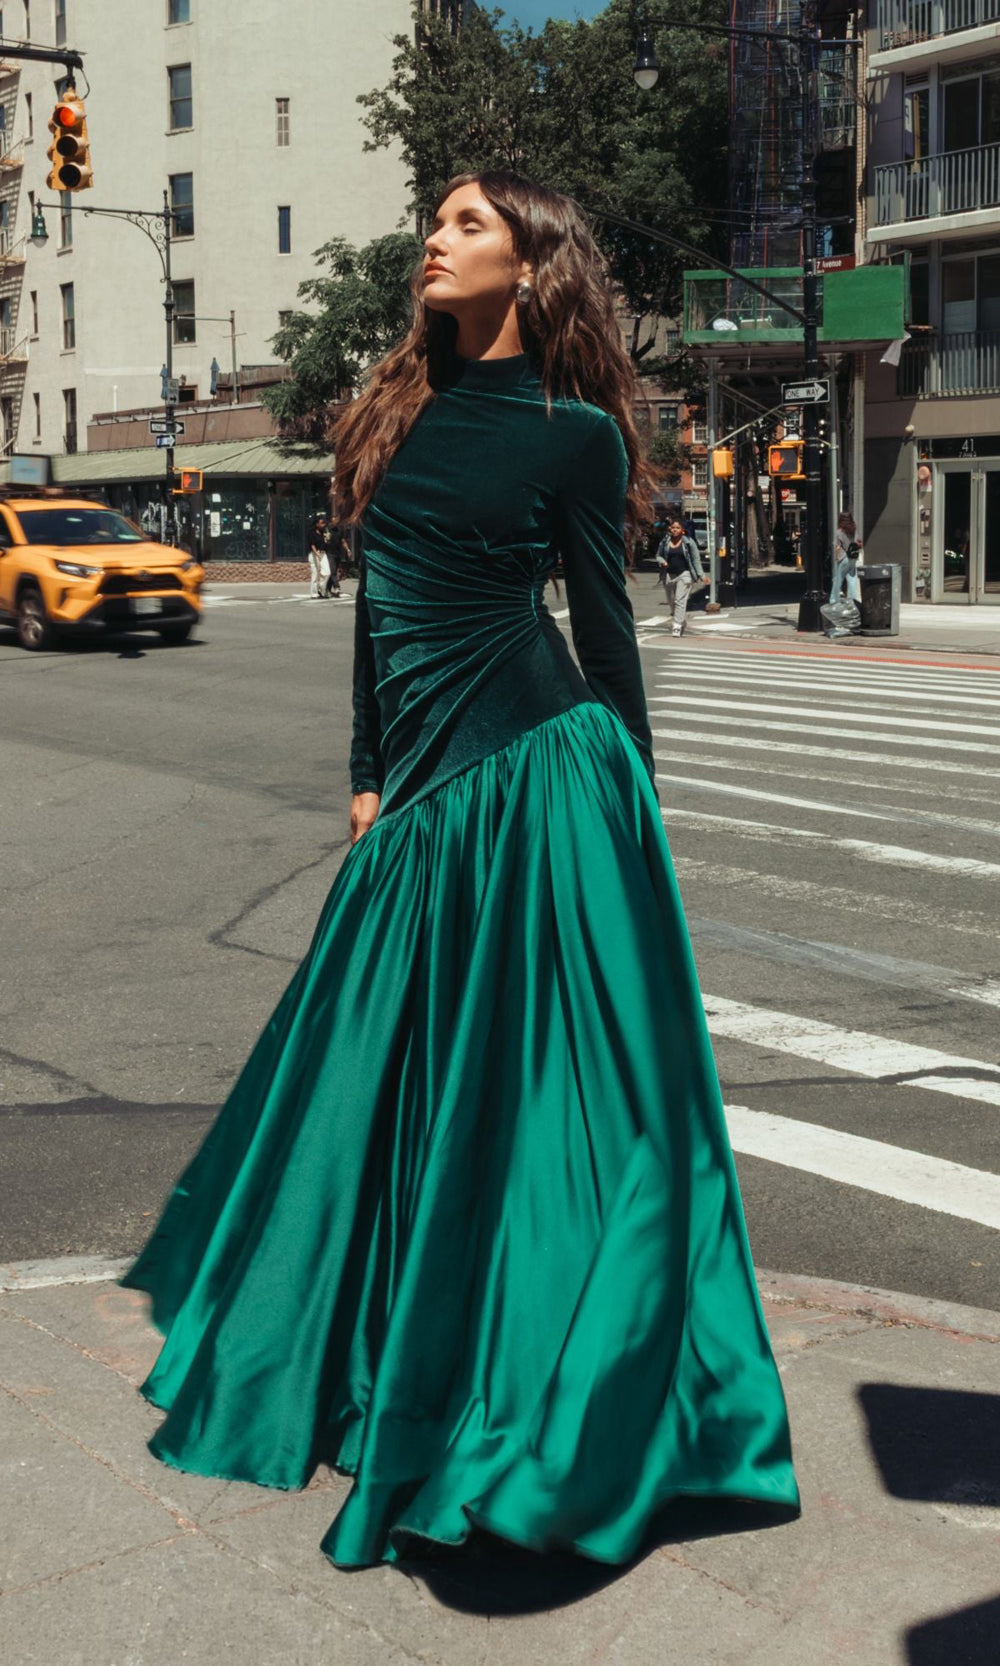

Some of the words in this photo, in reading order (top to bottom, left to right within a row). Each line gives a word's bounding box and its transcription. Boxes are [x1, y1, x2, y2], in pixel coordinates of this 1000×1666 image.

[822, 260, 842, 268] Avenue
[785, 389, 800, 399] ONE
[806, 387, 820, 397] WAY
[961, 438, 974, 452] 41
